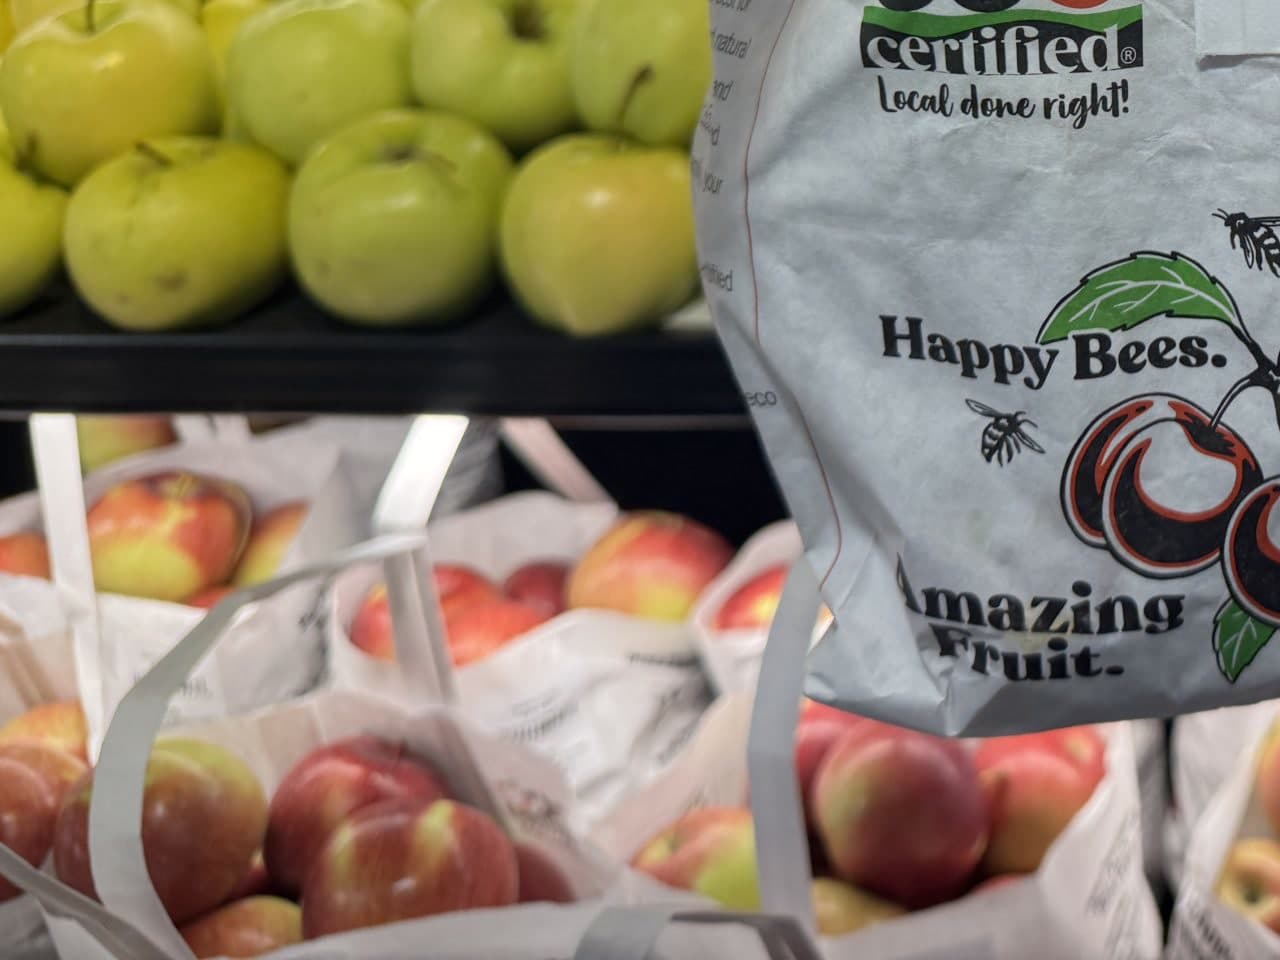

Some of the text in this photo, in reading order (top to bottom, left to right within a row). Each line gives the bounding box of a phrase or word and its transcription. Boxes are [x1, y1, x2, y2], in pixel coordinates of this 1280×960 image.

[877, 74, 1130, 130] Local done right!
[879, 314, 1228, 390] Happy Bees.
[928, 622, 1125, 682] Fruit.
